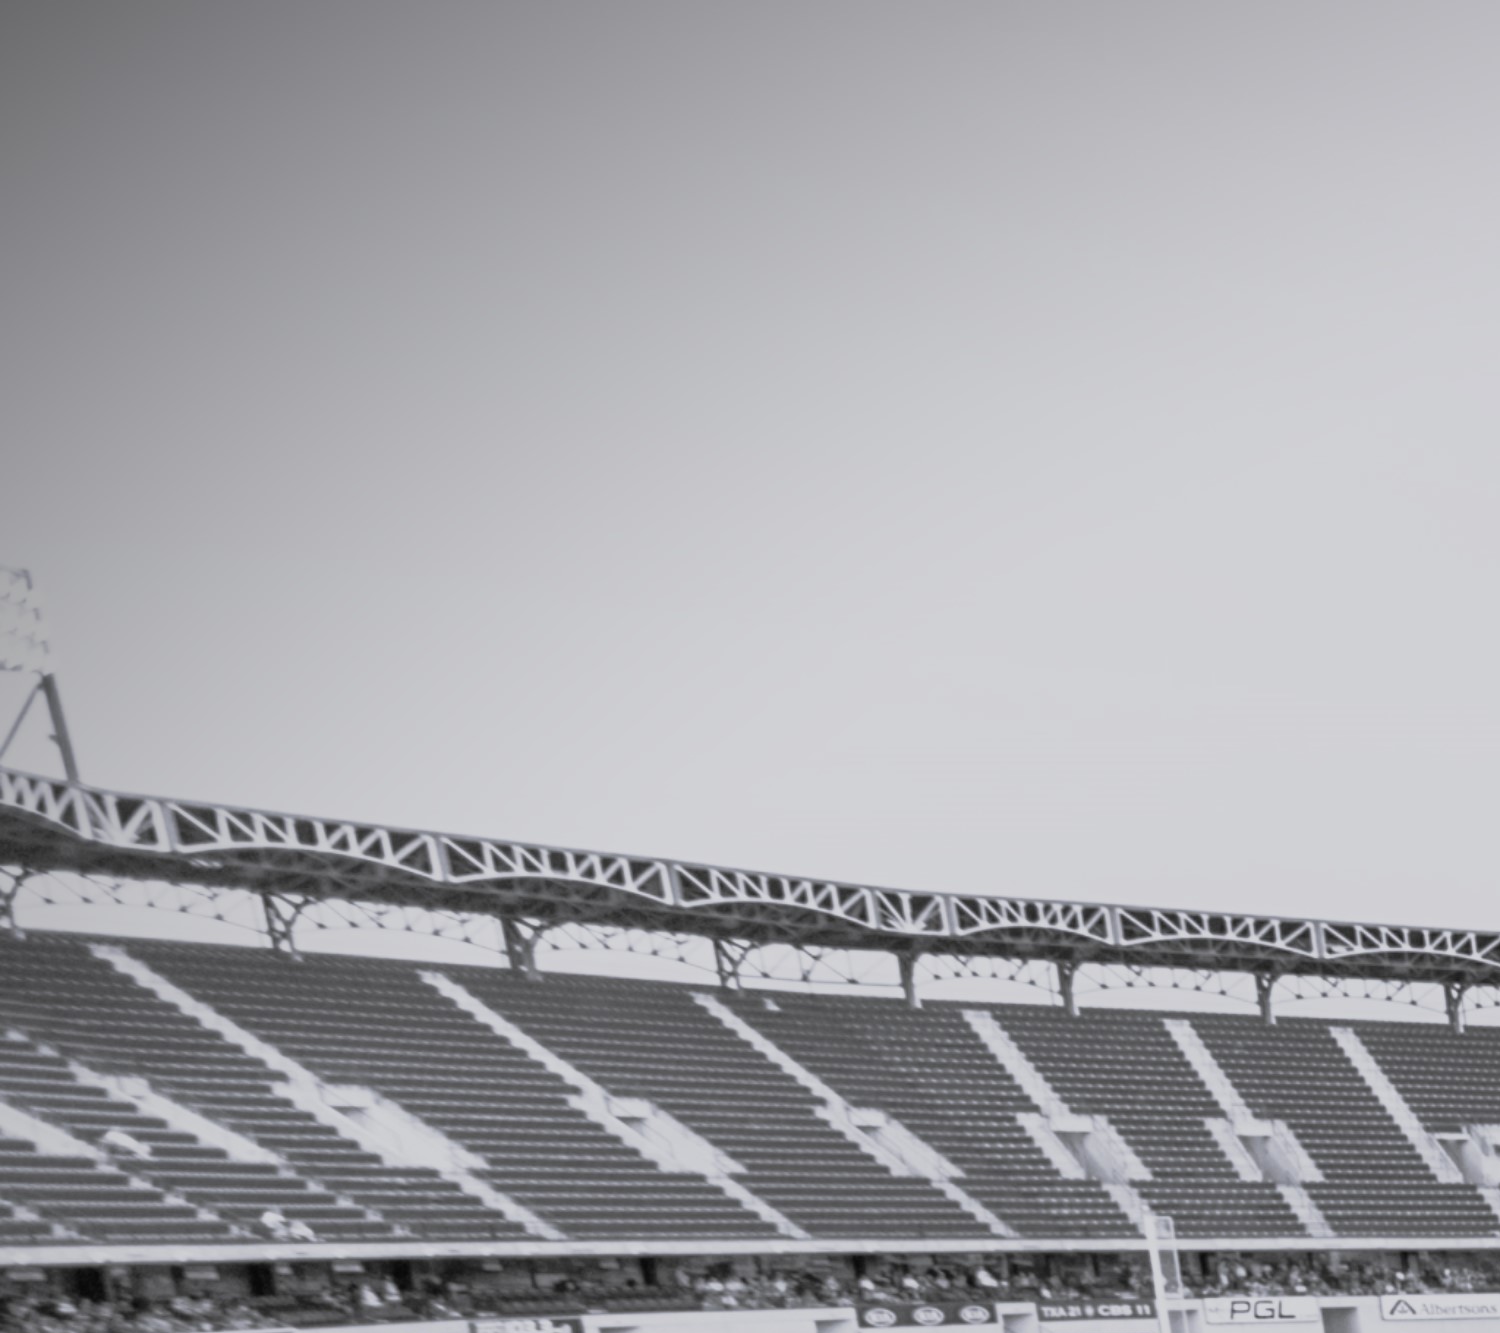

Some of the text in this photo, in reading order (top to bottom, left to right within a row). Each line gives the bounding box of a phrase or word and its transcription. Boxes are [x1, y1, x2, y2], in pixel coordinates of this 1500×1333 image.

[1097, 1305, 1133, 1316] CBS
[1230, 1300, 1297, 1320] PGL
[1419, 1301, 1498, 1316] Albertsons
